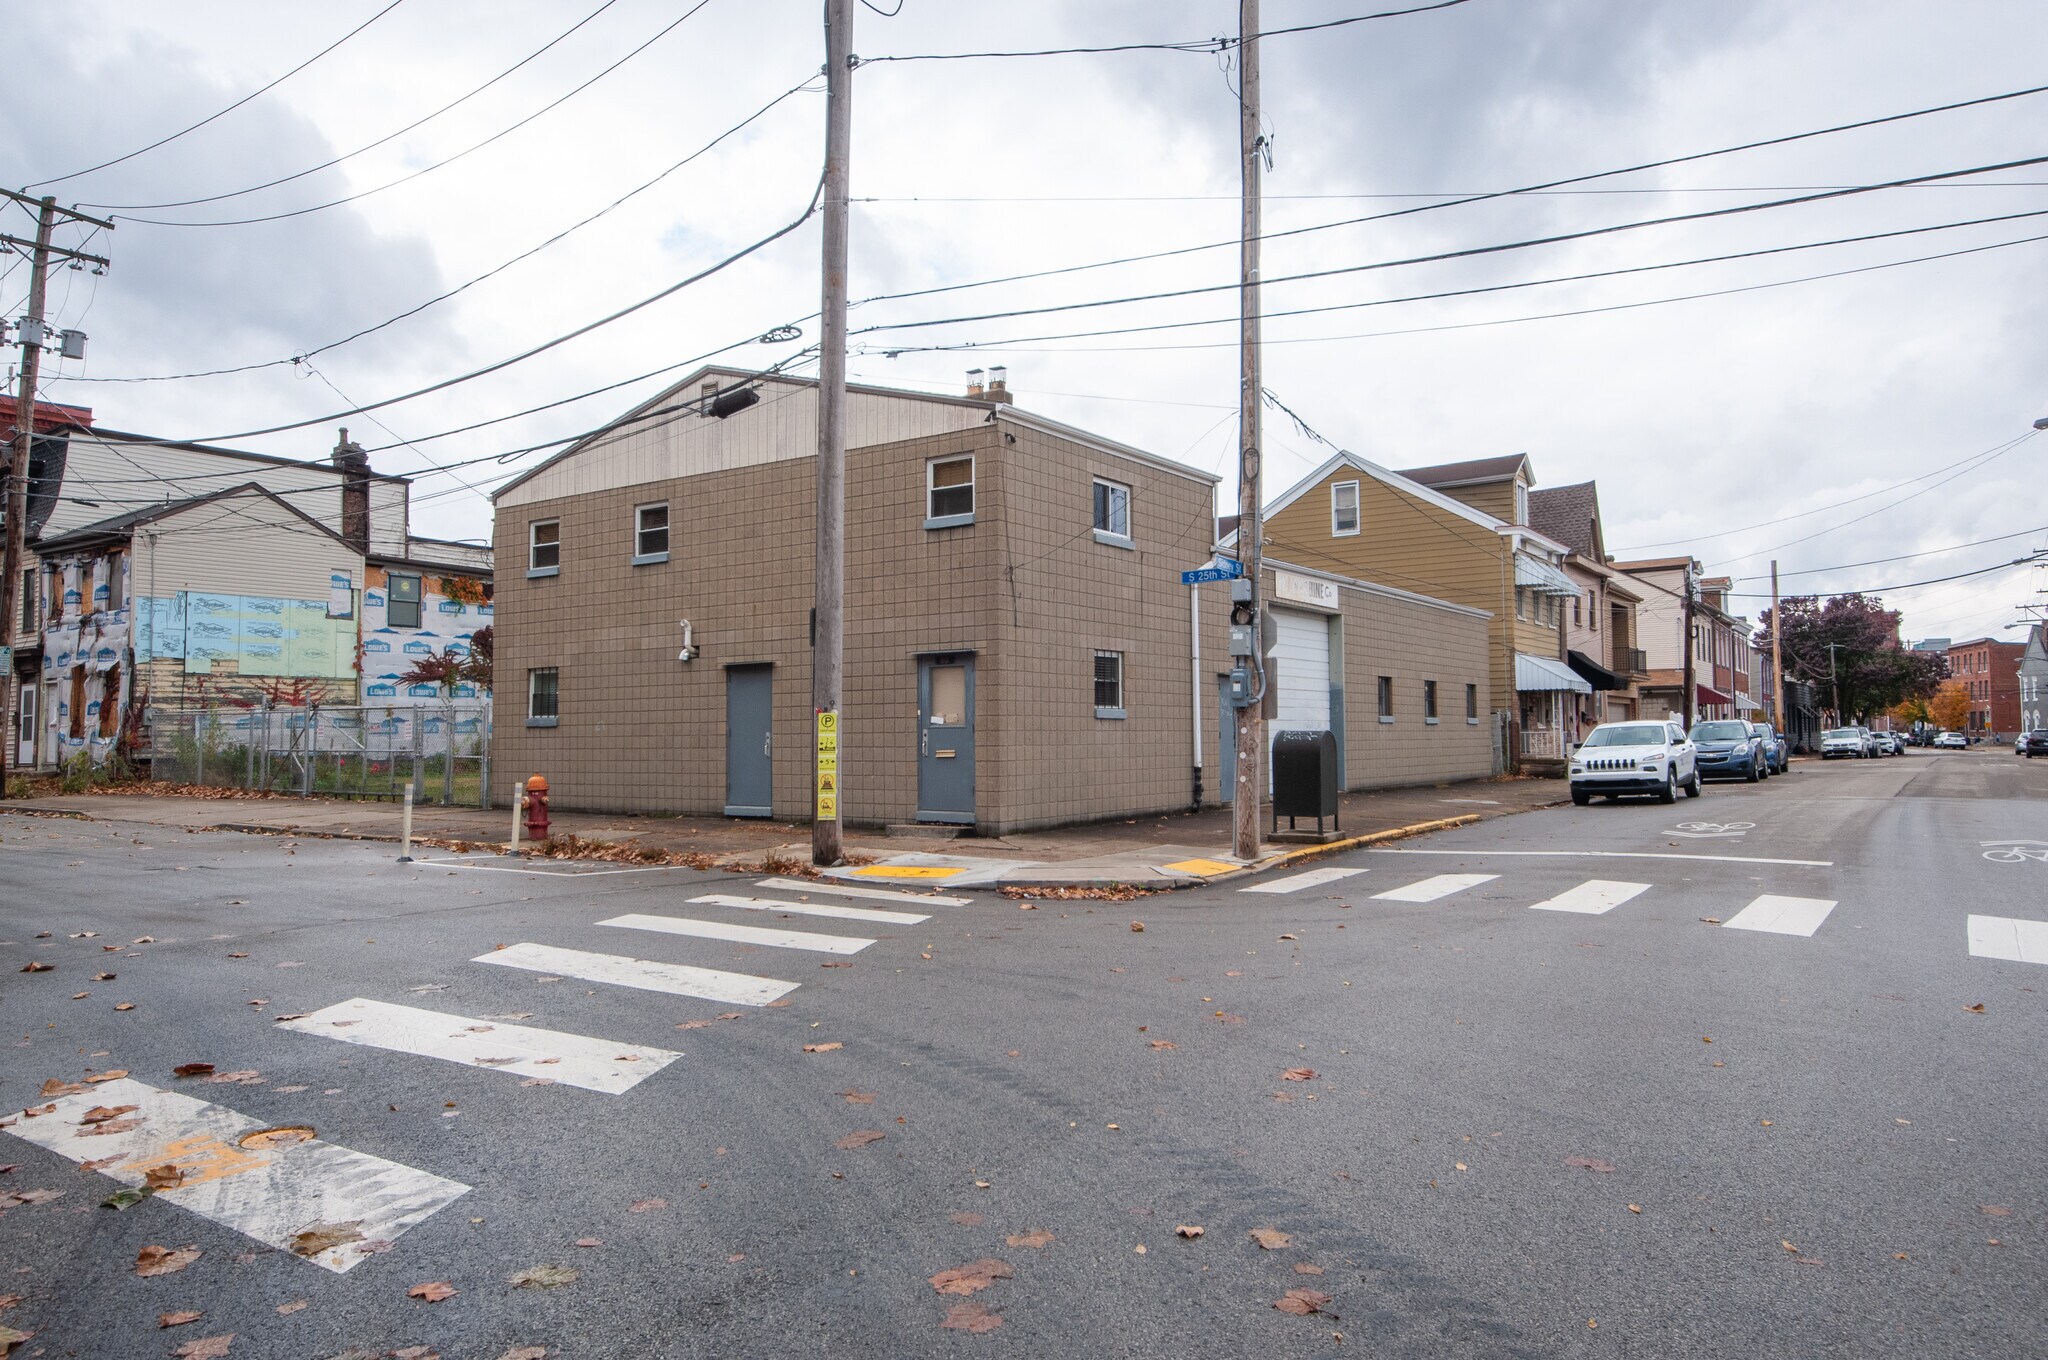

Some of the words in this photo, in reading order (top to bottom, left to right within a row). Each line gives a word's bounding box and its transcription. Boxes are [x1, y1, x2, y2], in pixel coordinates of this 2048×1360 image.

[1236, 563, 1242, 574] St
[1188, 572, 1195, 582] S
[1198, 570, 1217, 581] 25th
